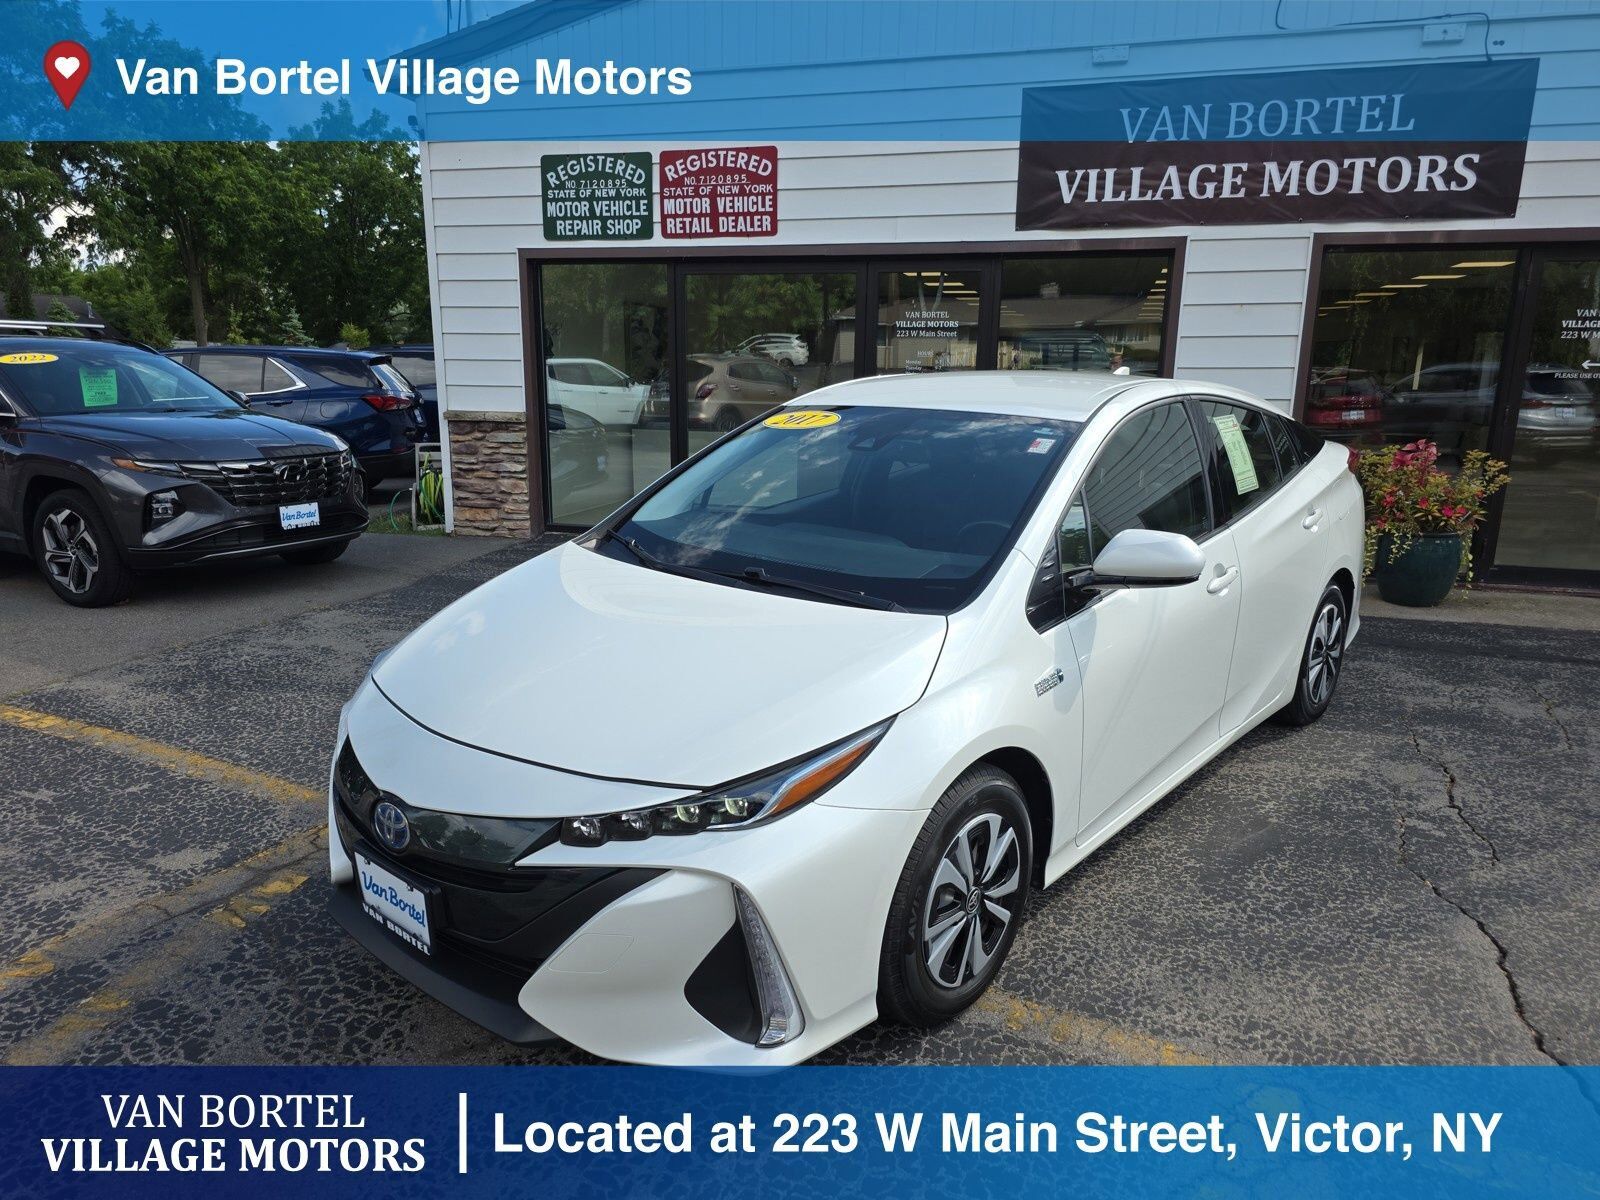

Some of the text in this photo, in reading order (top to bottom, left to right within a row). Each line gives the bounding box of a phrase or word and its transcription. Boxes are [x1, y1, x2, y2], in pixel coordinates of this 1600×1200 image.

[1119, 93, 1415, 143] VAN BORTEL
[546, 155, 646, 188] REGISTERED
[664, 150, 772, 182] REGISTERED
[580, 179, 627, 188] 7120895
[699, 174, 747, 184] 7120895
[1055, 153, 1481, 204] VILLAGE MOTORS
[547, 188, 646, 198] STATE OF NEW YORK
[663, 184, 773, 196] STATE OF NEW YORK
[546, 200, 648, 218] MOTOR VEHICLE
[663, 195, 773, 215] MOTOR VEHICLE
[556, 219, 641, 235] REPAIR SHOP
[666, 215, 771, 234] RETAIL DEALER
[921, 310, 950, 318] BORTEL
[1576, 309, 1598, 317] VAN
[895, 320, 959, 328] VILLAGE MOTORS
[1561, 331, 1579, 339] 223
[1580, 331, 1591, 339] W
[10, 354, 47, 362] 2022
[770, 413, 832, 426] 2017
